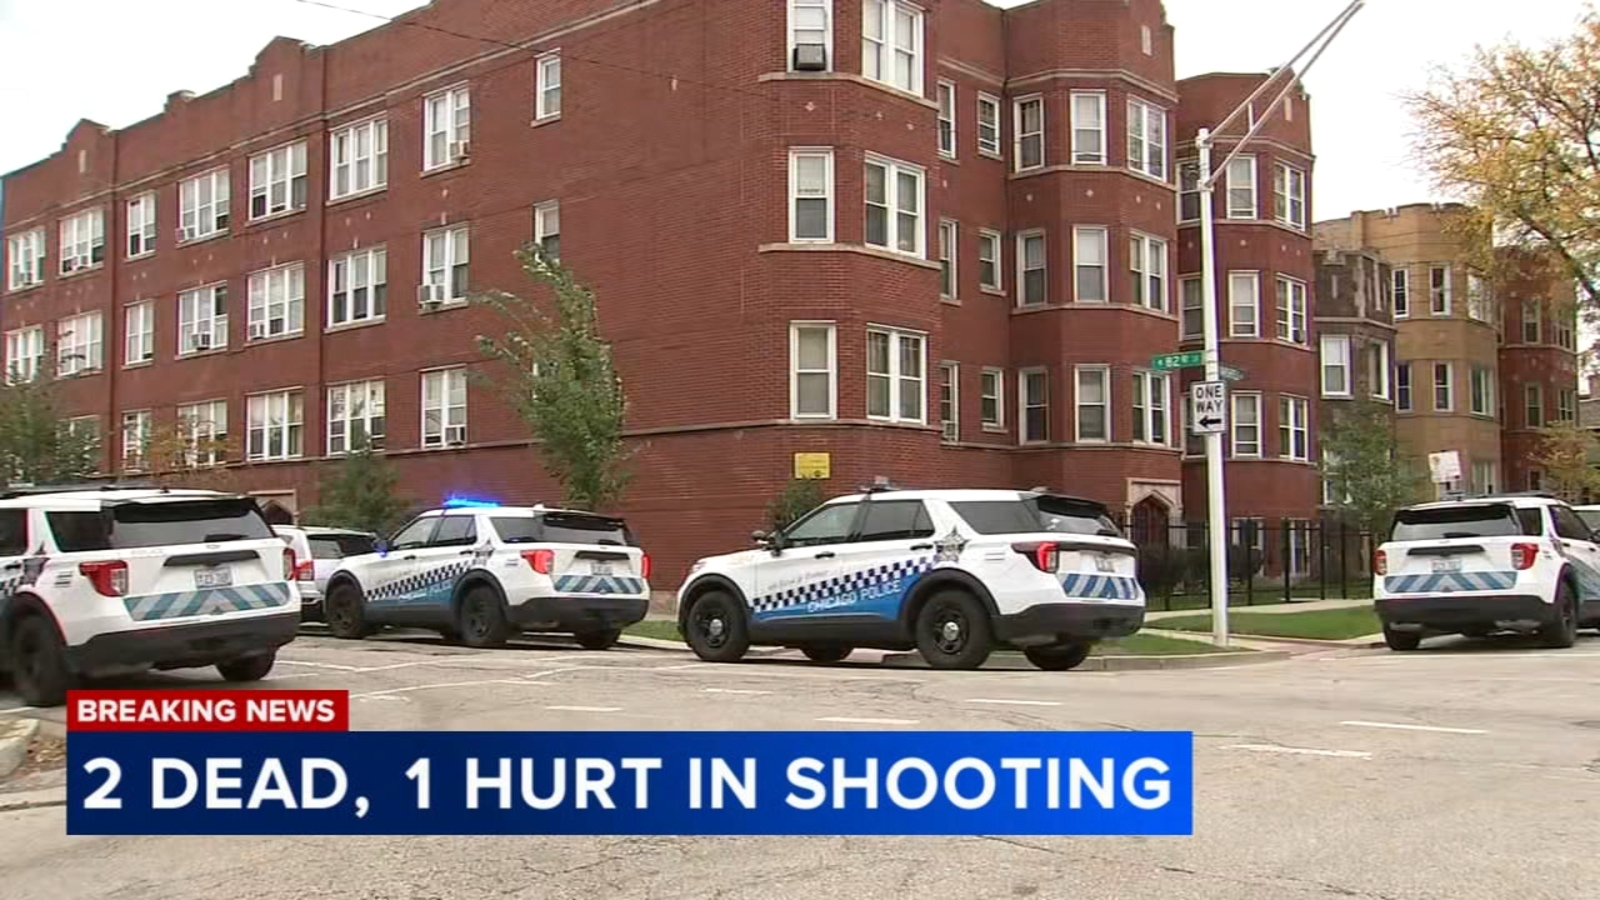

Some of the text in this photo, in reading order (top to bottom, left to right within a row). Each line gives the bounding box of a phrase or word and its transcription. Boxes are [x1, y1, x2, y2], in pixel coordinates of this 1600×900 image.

[1195, 385, 1222, 399] ONE
[1195, 400, 1223, 413] WAY
[807, 579, 901, 612] CHICAGO POLICE
